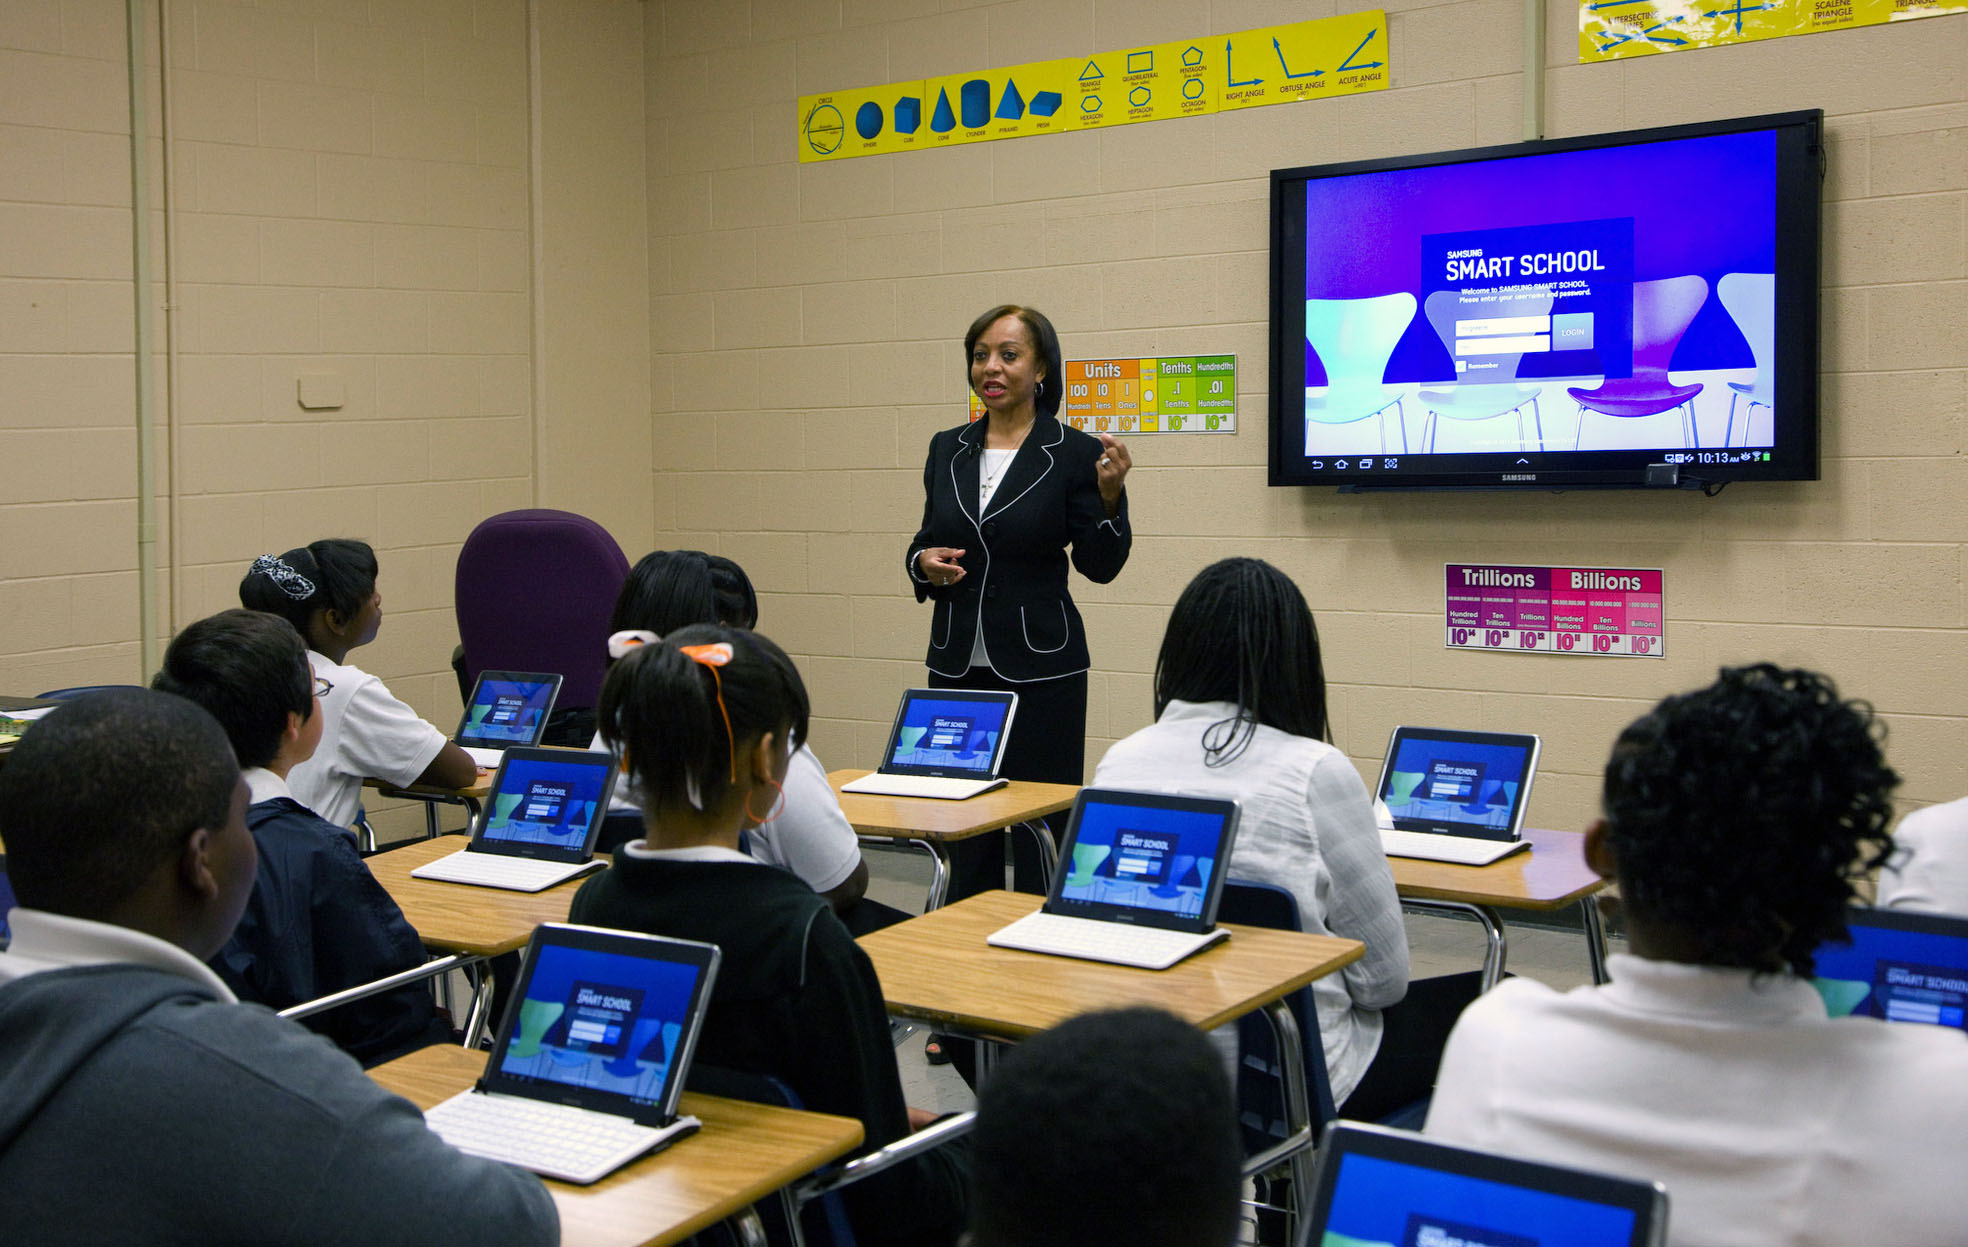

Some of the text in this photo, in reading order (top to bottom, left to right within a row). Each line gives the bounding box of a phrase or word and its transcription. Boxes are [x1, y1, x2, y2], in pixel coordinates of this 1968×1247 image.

[1815, 0, 1851, 10] SCALENE
[1813, 7, 1853, 20] TRIANGLE
[1339, 73, 1382, 85] ACUTE ANGLE
[1280, 81, 1325, 93] OBTUSE ANGLE
[1226, 89, 1265, 100] RIGHT ANGLE
[1447, 249, 1482, 259] SAMSUNG
[1446, 250, 1605, 281] SMART SCHOOL
[1461, 287, 1490, 295] Welcome
[1561, 328, 1585, 337] LOGIN
[1085, 362, 1121, 378] Units
[1161, 362, 1192, 374] Tenths
[1197, 362, 1234, 371] Hundredths
[1070, 384, 1088, 397] 100
[1098, 383, 1108, 397] 10
[1208, 380, 1223, 394] .01
[1096, 401, 1111, 409] Tens
[1118, 401, 1137, 409] Ones
[1165, 400, 1190, 408] Tenths
[1198, 399, 1234, 408] Hundredths
[1698, 452, 1728, 464] 10:13
[1462, 569, 1535, 588] Trillions
[1571, 572, 1642, 591] Billions
[1520, 613, 1545, 621] Trillions
[1554, 615, 1584, 623] Hundred
[1485, 619, 1510, 627] Trillions
[1556, 622, 1581, 630] Billions
[1631, 620, 1657, 628] Billions
[1120, 837, 1169, 850] SMART SCHOOL
[576, 992, 631, 1012] SMART SCHOOL
